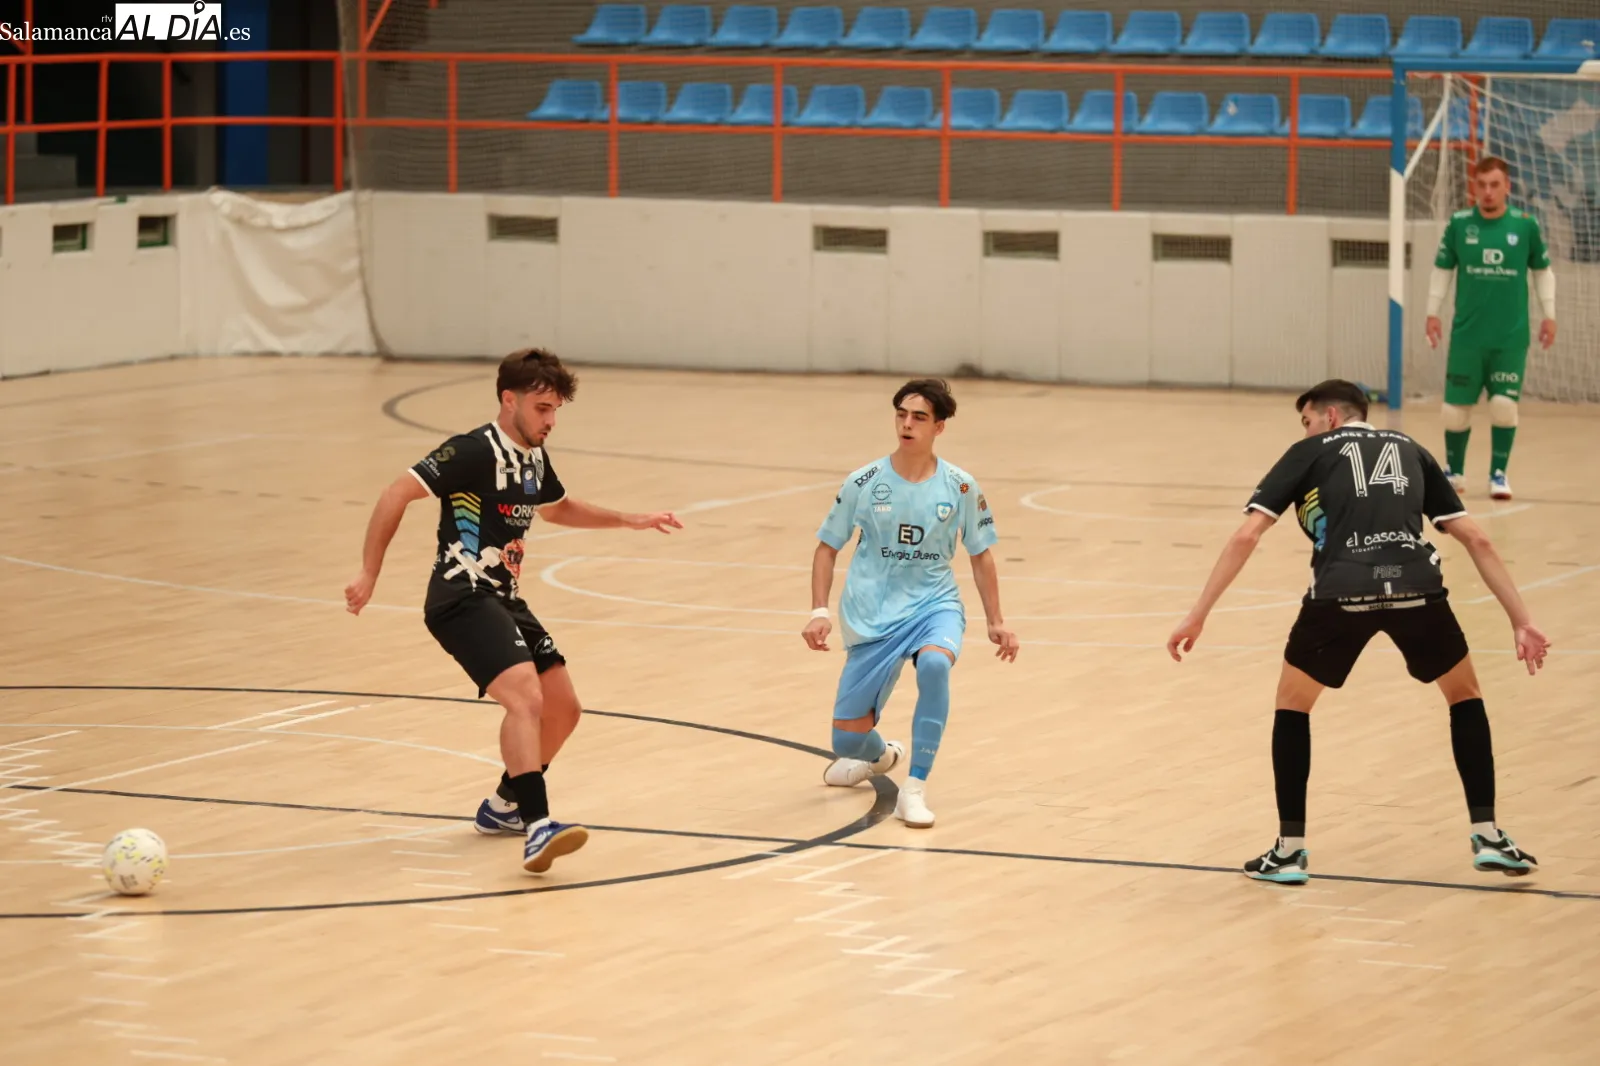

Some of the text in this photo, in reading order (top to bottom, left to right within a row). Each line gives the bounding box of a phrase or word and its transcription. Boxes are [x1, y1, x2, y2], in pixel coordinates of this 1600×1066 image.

[1339, 441, 1409, 498] 14
[497, 503, 537, 518] WORK
[898, 523, 925, 546] ED
